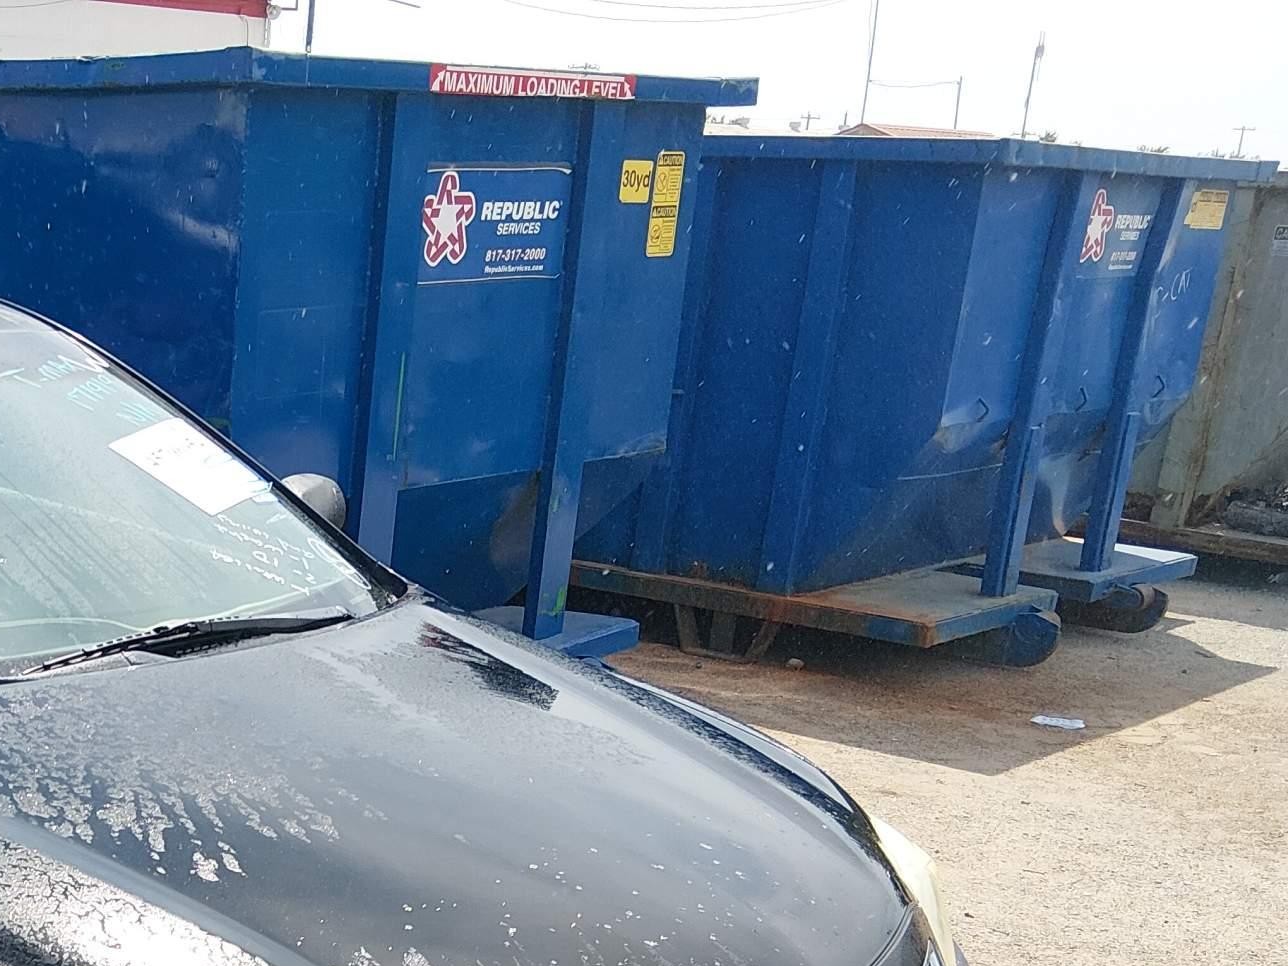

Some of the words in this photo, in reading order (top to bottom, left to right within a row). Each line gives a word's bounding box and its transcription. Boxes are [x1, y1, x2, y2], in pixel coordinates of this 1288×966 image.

[444, 71, 514, 95] MAXIMUM
[518, 76, 580, 97] LOADING
[622, 170, 652, 192] 30yd
[481, 201, 560, 221] REPUBLIC
[496, 222, 541, 235] SERVICES
[485, 247, 547, 263] 817-317-2000
